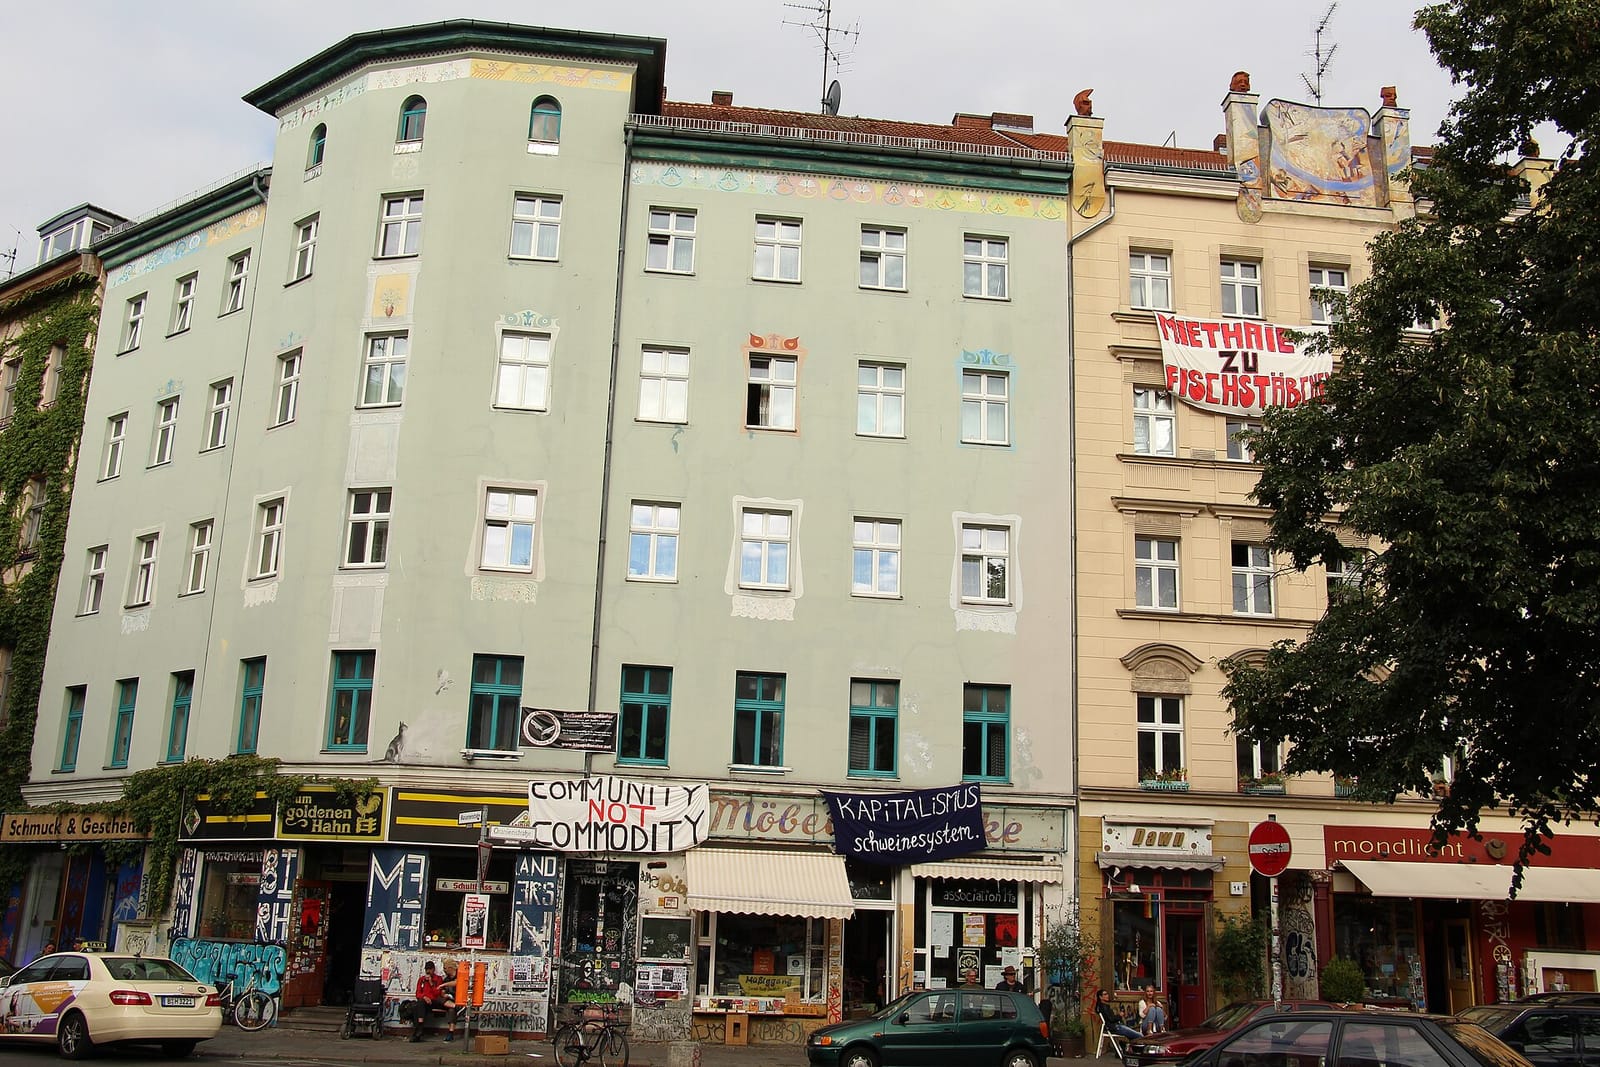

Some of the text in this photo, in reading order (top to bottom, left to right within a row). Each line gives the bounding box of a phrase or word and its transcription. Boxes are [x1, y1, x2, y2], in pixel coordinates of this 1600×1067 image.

[1157, 313, 1295, 353] MIETHAIE
[1218, 351, 1258, 374] ZU
[295, 795, 312, 804] um
[531, 776, 702, 806] COMMUNITY
[286, 805, 352, 826] goldenen
[588, 799, 656, 827] NOT
[9, 817, 62, 836] Schmuck
[67, 818, 76, 834] &
[311, 819, 351, 833] Hahn
[533, 810, 705, 851] COMMODITY
[1132, 828, 1185, 847] Dawn
